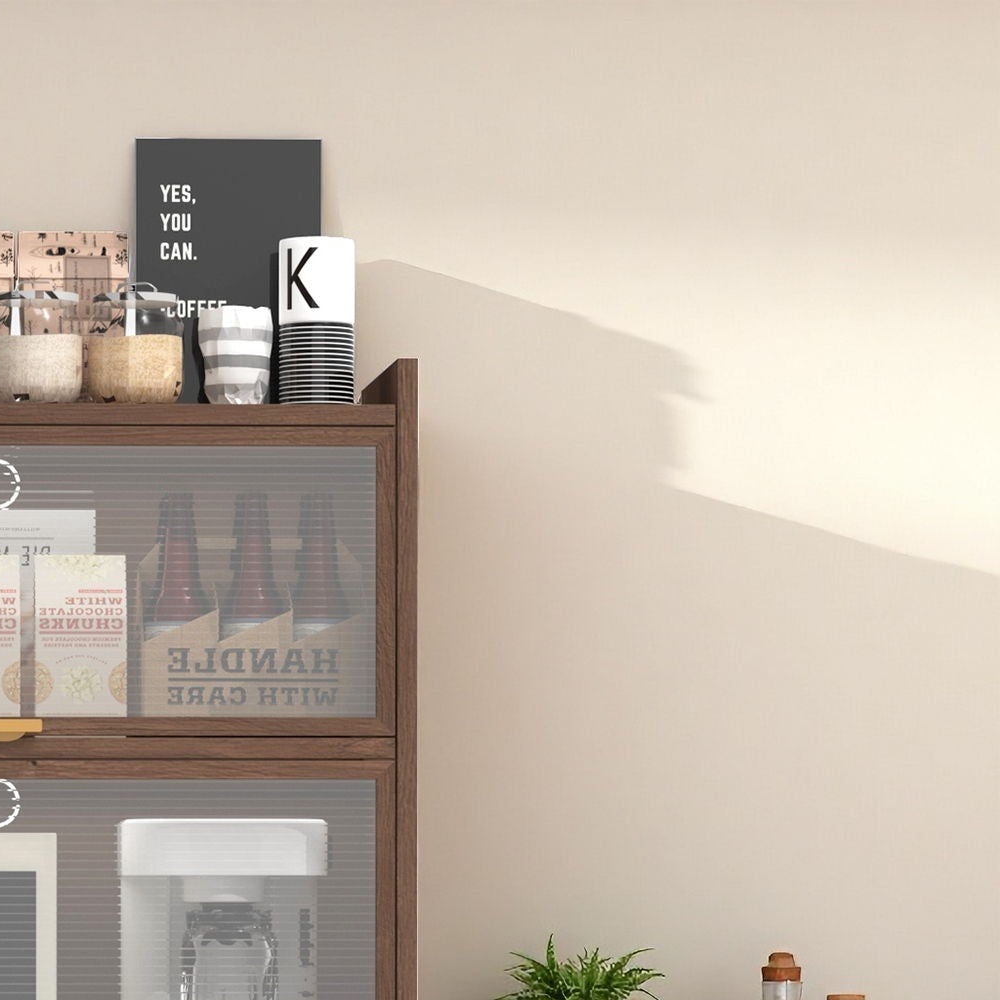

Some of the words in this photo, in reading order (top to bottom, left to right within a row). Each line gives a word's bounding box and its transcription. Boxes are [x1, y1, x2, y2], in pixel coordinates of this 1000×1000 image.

[160, 184, 196, 205] YES,
[160, 213, 191, 232] YOU
[160, 242, 197, 260] CAN.
[287, 247, 320, 310] K
